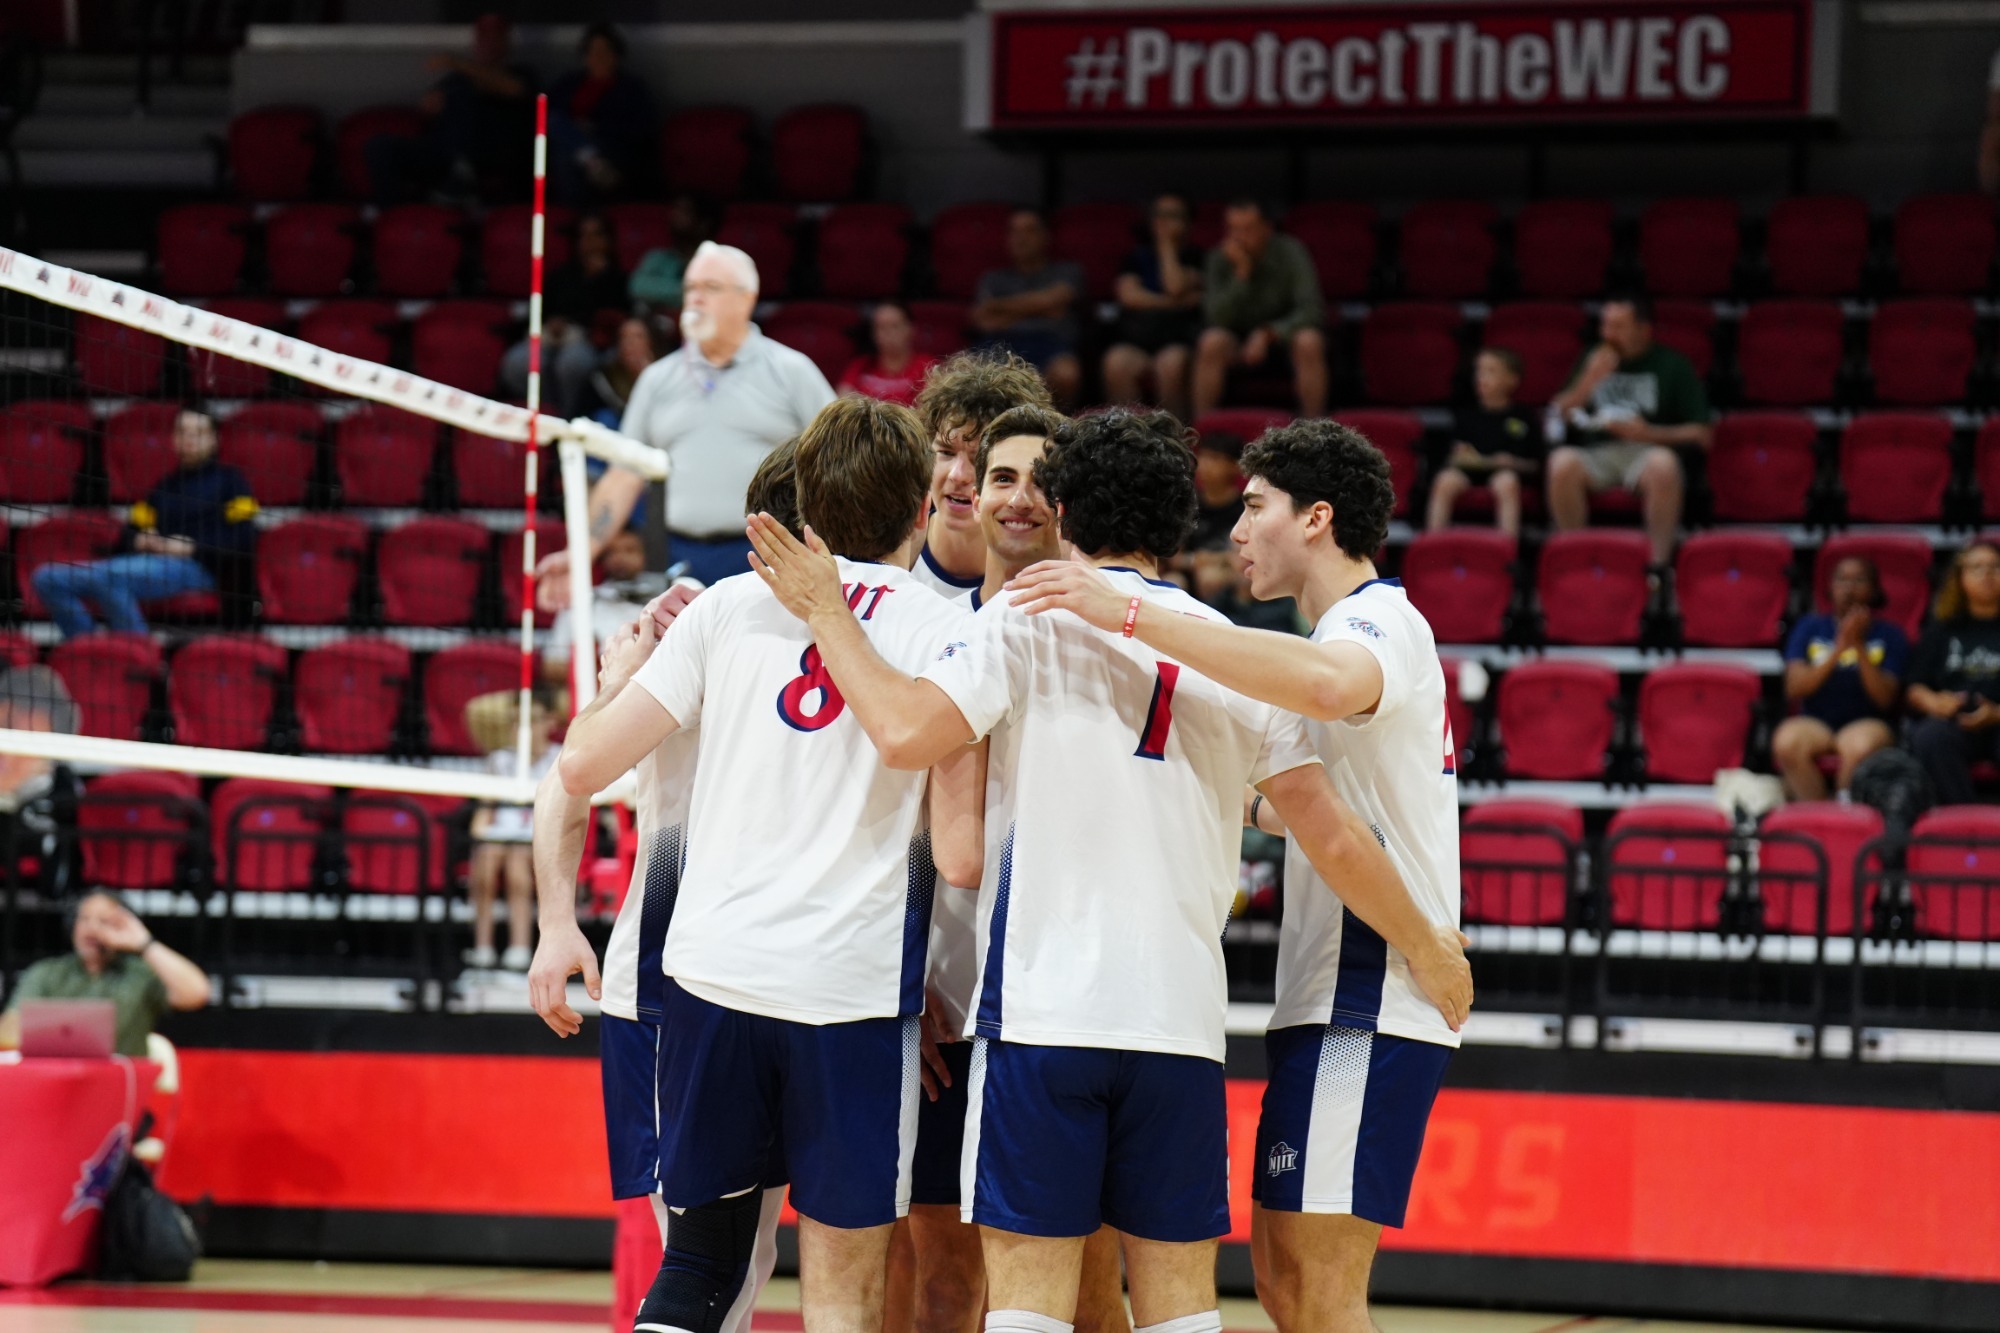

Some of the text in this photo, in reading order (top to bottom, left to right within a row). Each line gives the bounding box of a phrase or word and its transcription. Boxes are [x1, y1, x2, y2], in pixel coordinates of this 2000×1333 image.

[1066, 16, 1729, 107] #ProtectTheWEC
[777, 642, 846, 732] 8
[1269, 1153, 1295, 1177] NJIT
